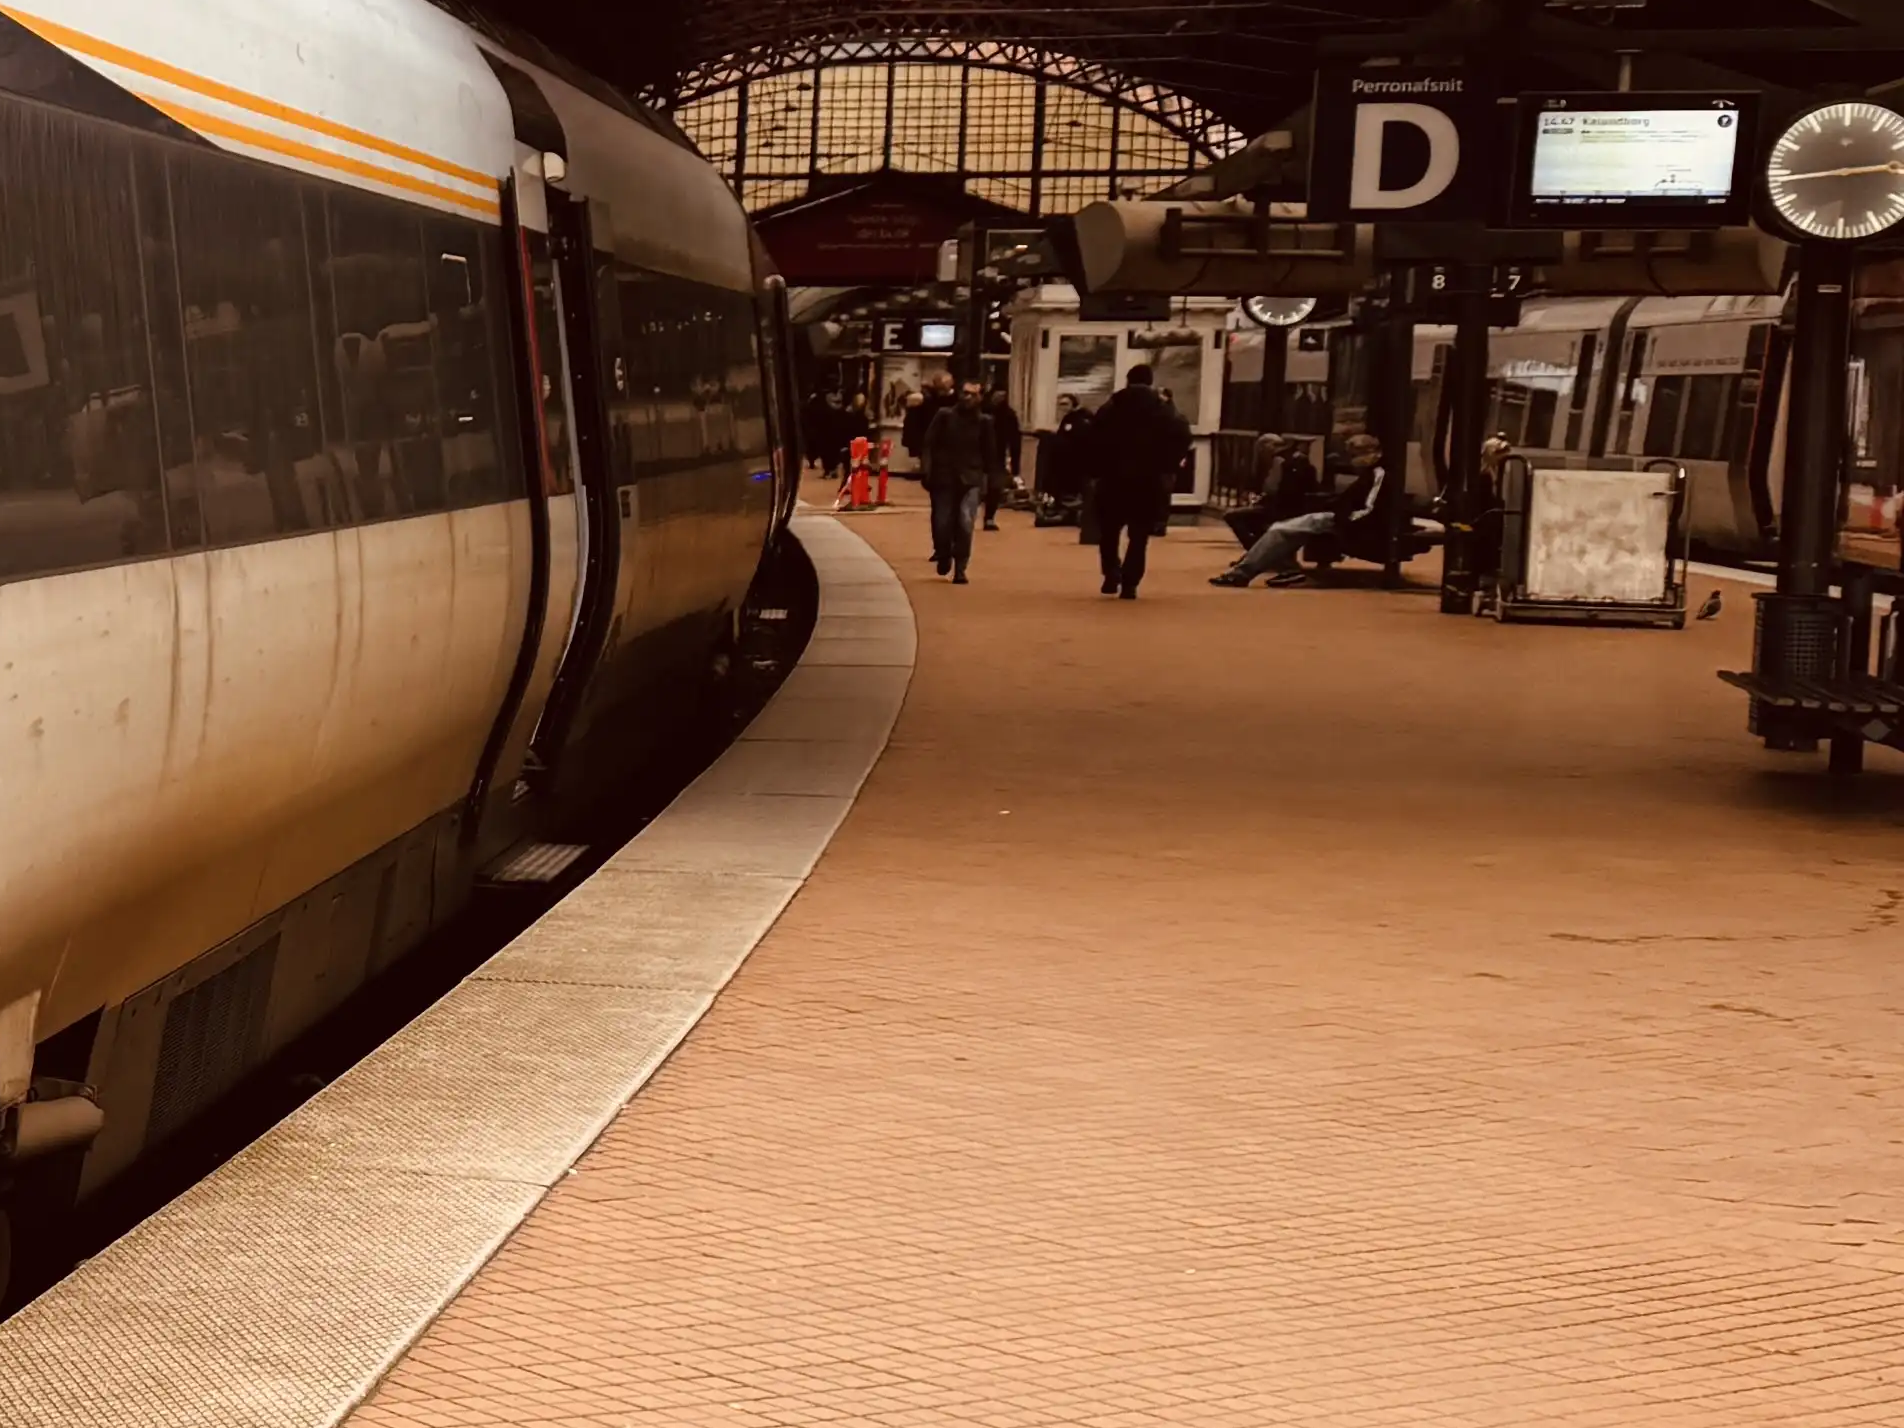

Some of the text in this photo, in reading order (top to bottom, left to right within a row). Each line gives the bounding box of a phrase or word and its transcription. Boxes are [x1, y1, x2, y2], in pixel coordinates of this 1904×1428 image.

[1352, 77, 1463, 93] Perronafsnit
[1349, 102, 1460, 209] D
[1431, 274, 1446, 290] 8
[882, 322, 904, 350] E
